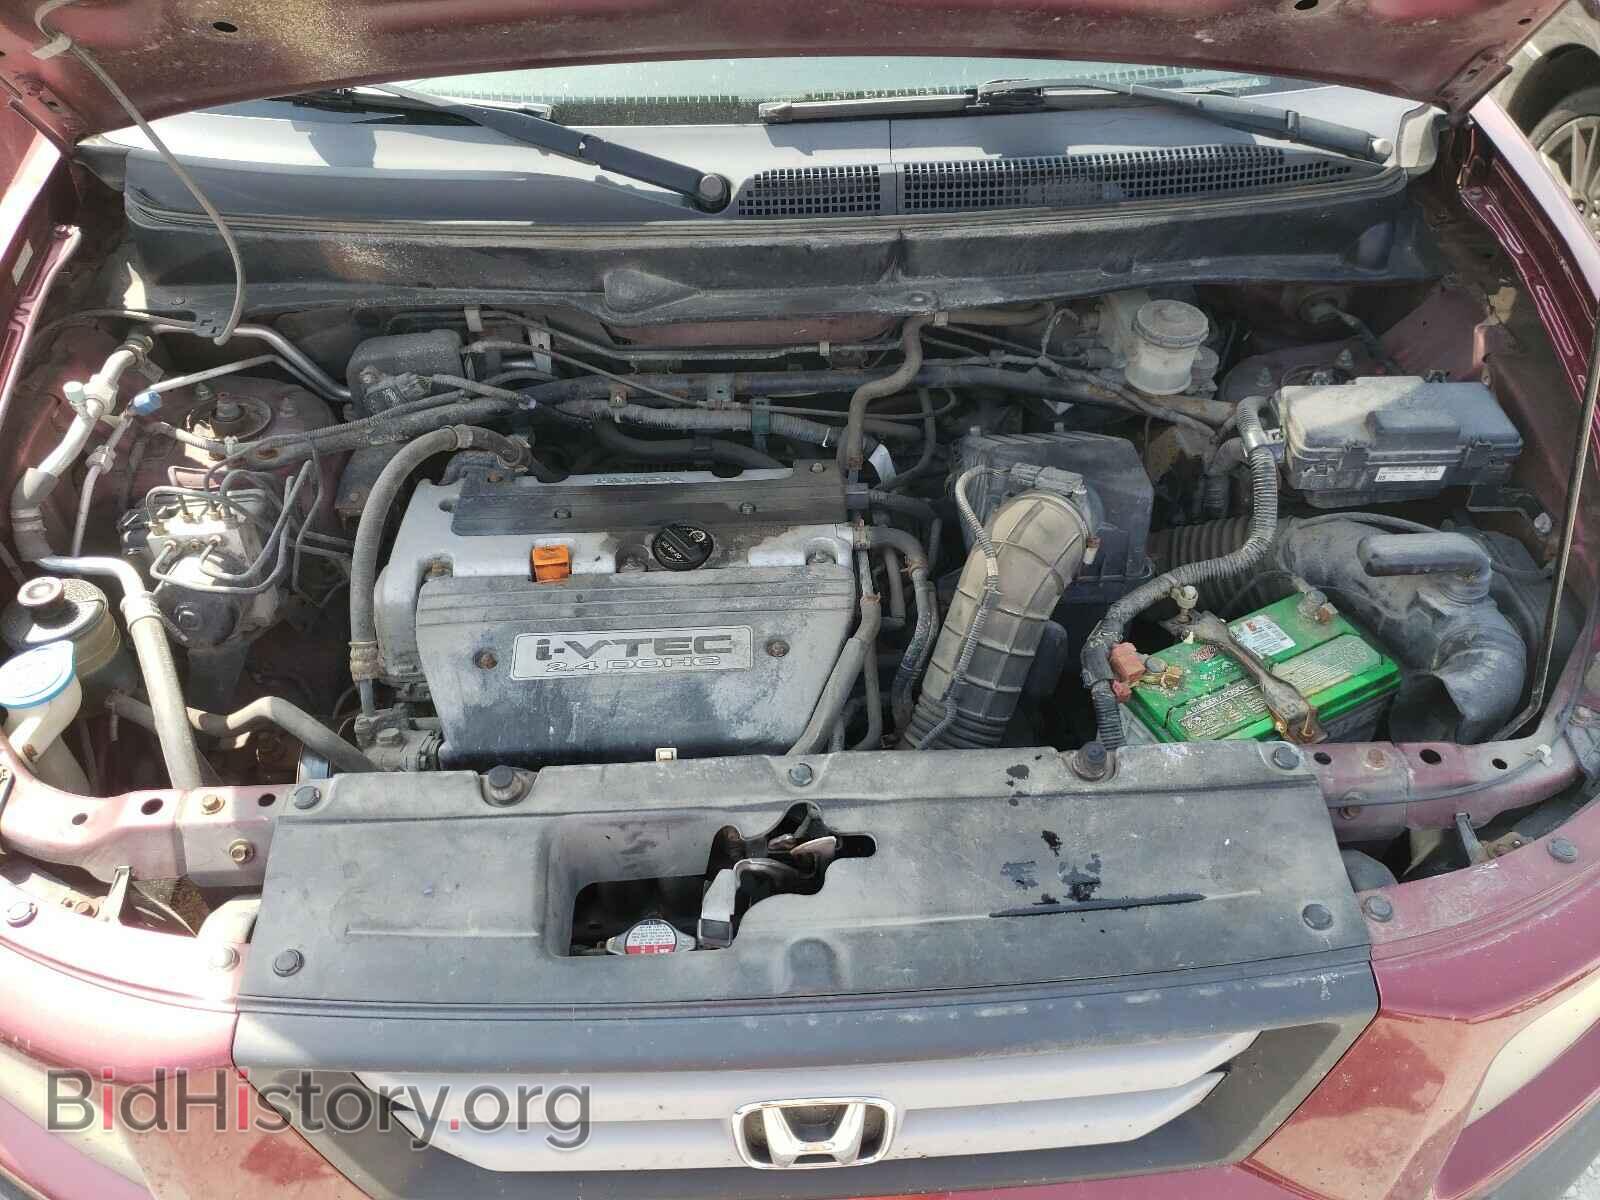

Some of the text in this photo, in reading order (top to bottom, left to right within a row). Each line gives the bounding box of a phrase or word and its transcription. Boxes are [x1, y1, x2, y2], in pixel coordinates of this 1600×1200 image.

[536, 635, 732, 661] i-VTEC
[546, 656, 721, 673] 2.4 DOHC
